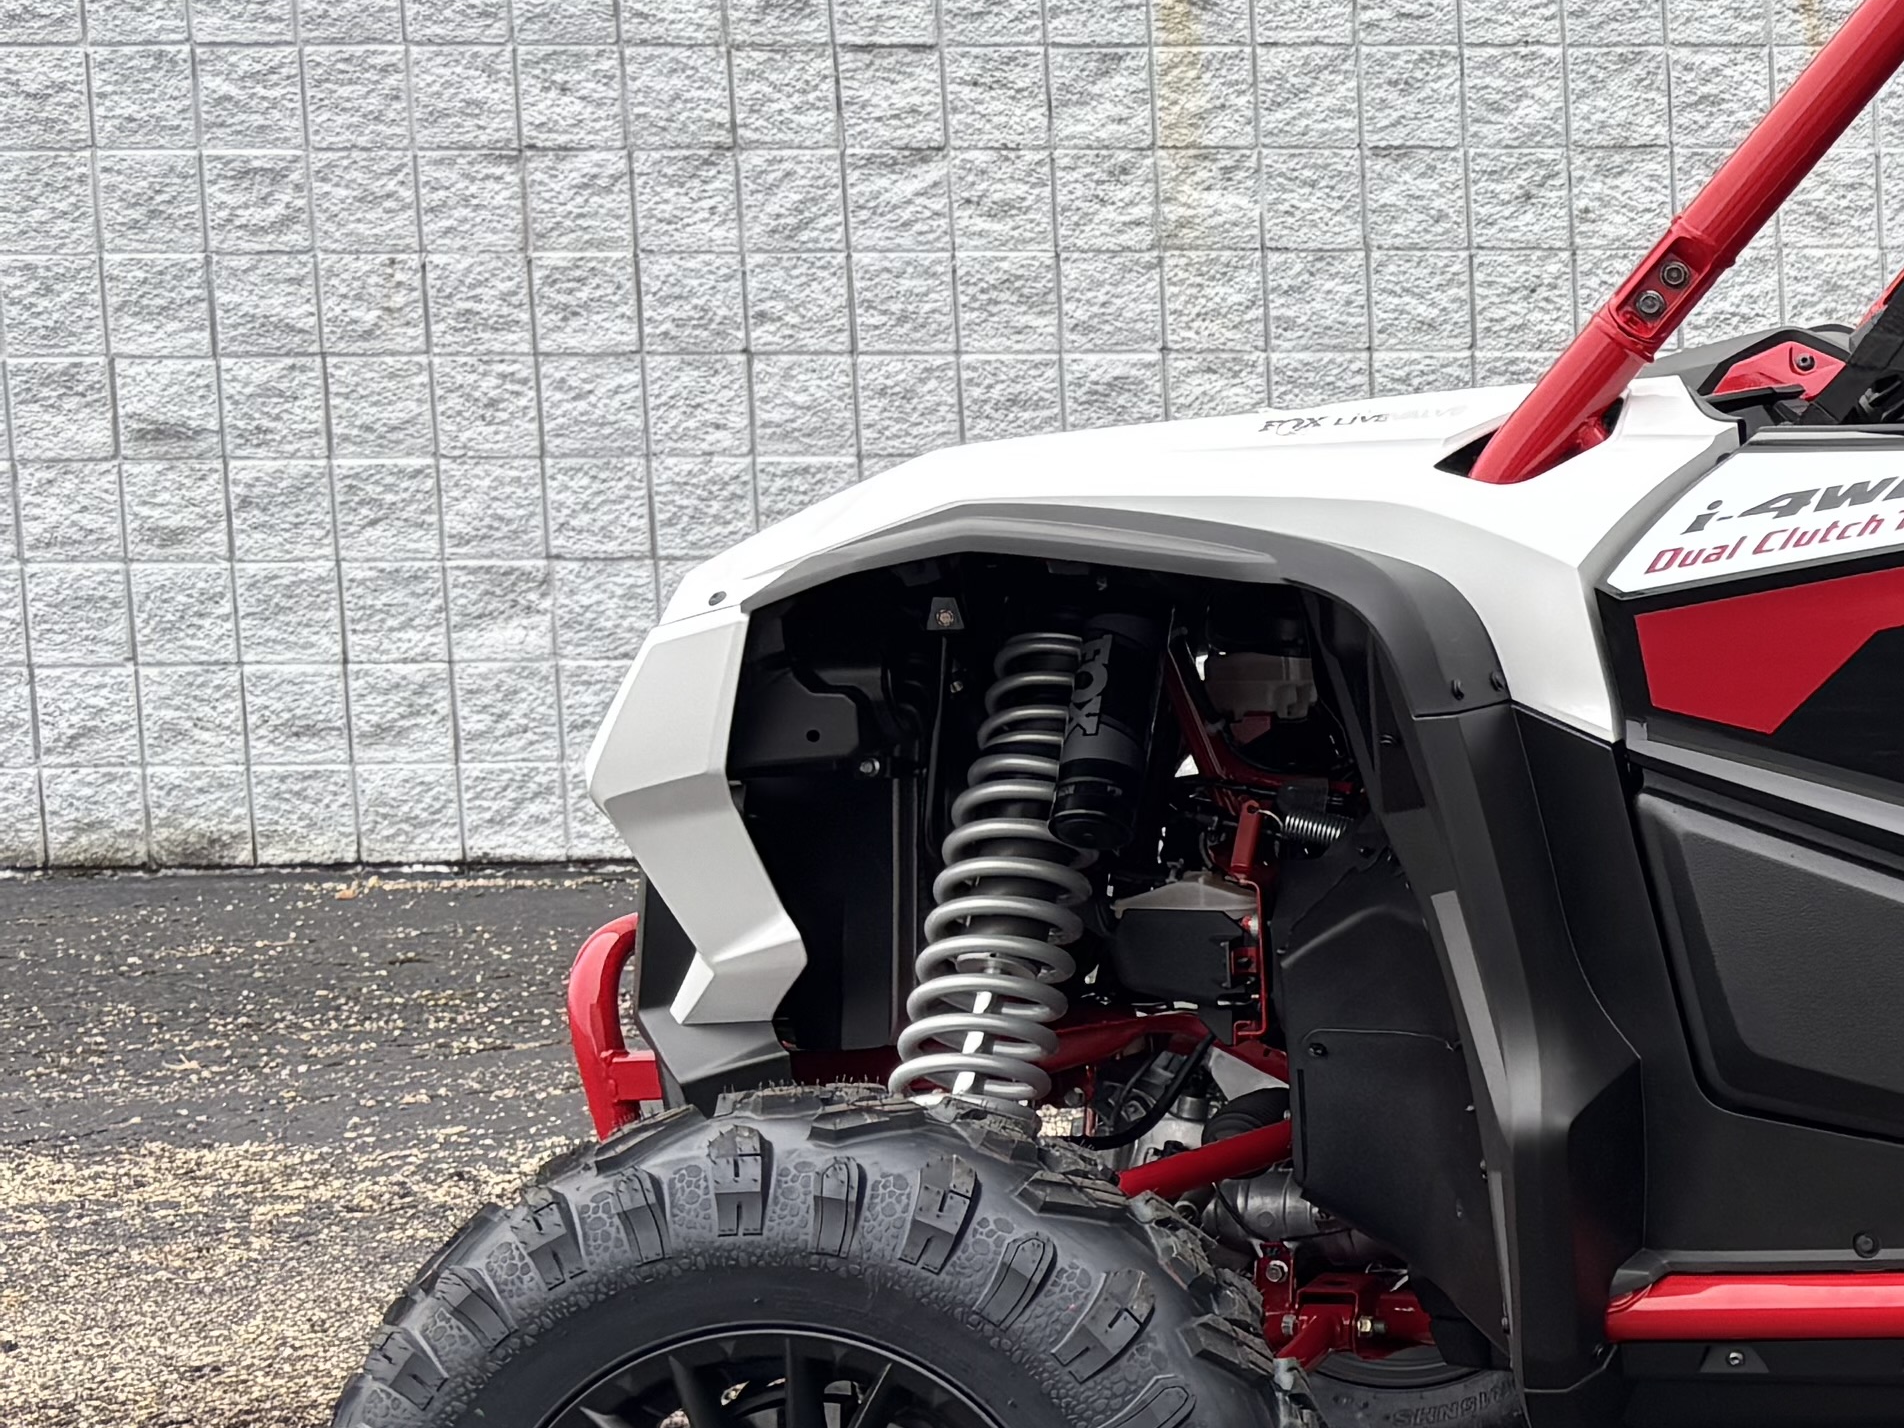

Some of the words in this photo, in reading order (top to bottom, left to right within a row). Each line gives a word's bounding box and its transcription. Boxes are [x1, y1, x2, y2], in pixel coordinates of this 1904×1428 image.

[1258, 415, 1328, 436] FOX
[1644, 542, 1740, 575] Dual
[1752, 514, 1885, 557] Clutch
[1068, 634, 1113, 736] FOX
